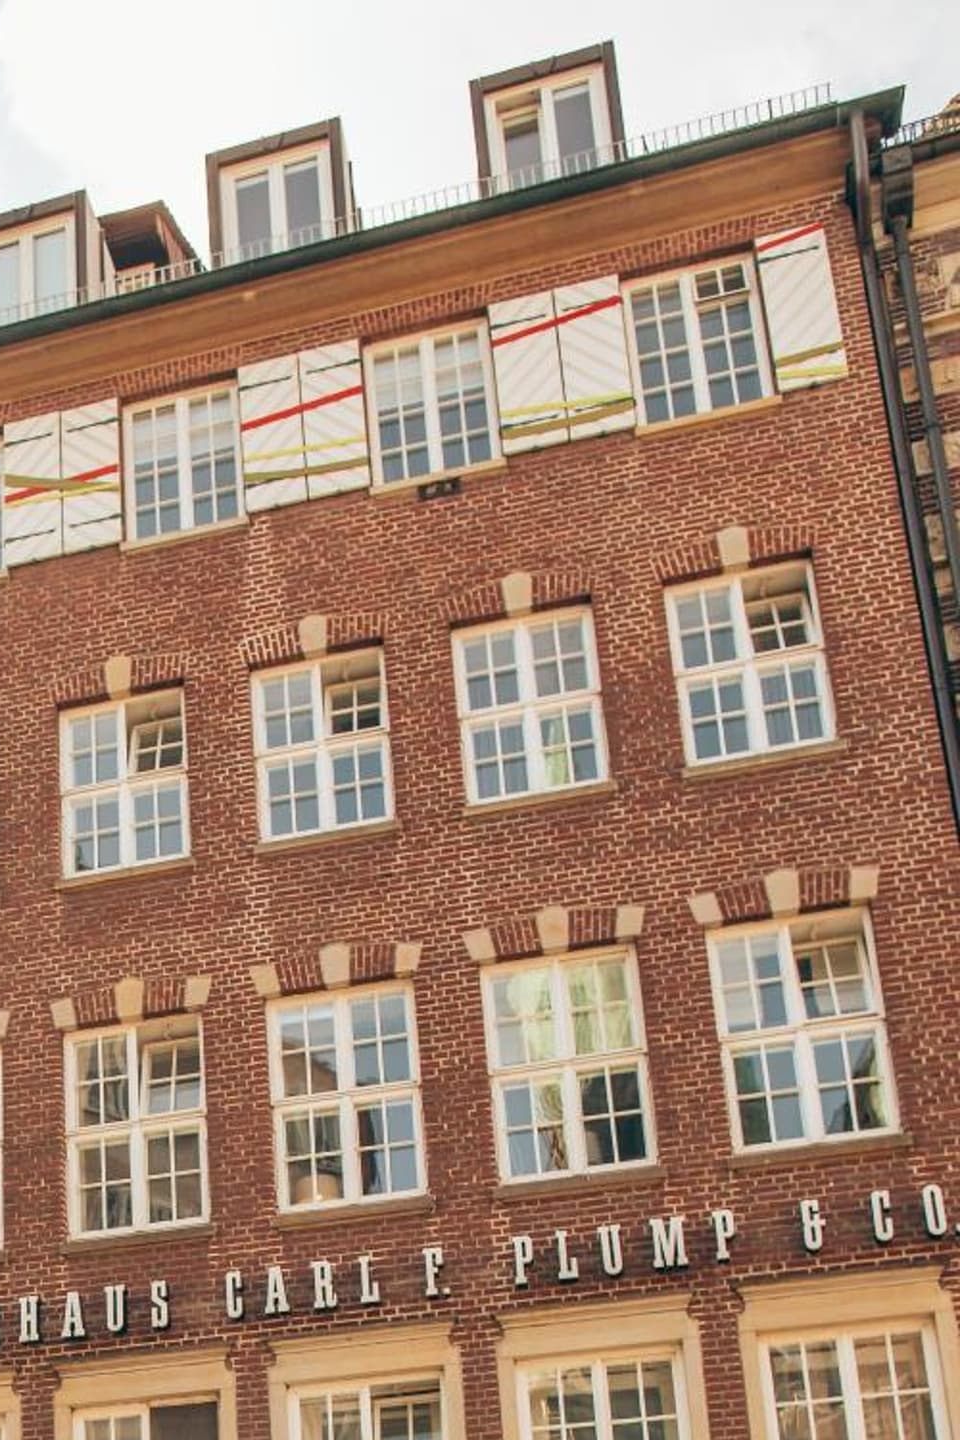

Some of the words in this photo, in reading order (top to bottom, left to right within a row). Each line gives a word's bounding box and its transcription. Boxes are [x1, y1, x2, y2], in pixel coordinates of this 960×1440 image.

[226, 1254, 381, 1318] CARL
[422, 1247, 450, 1297] F.
[511, 1208, 735, 1285] PLUMP
[800, 1199, 826, 1250] &
